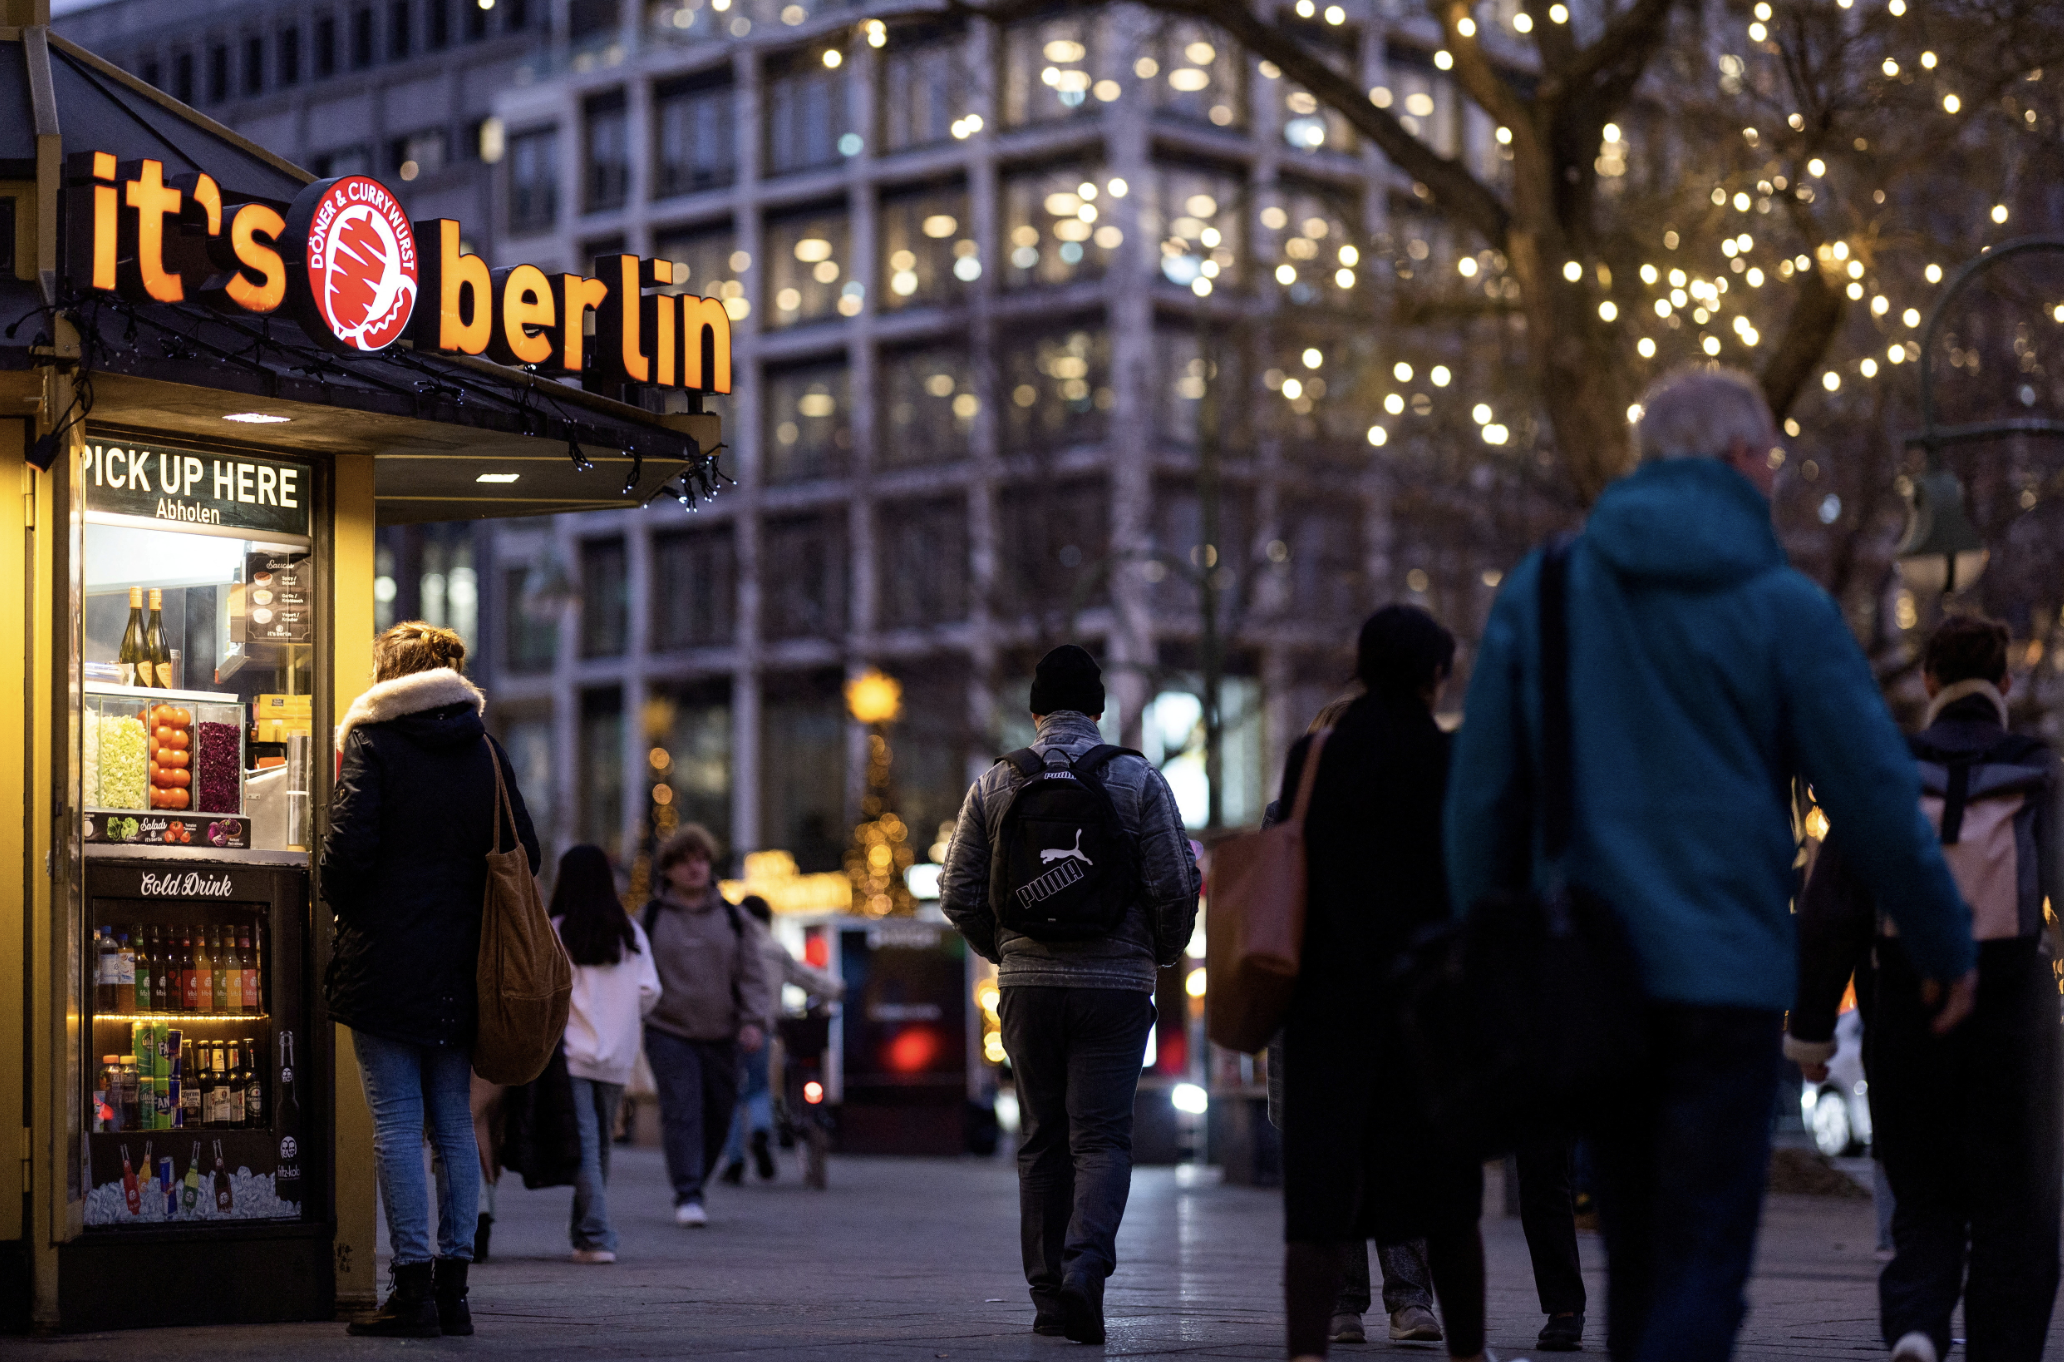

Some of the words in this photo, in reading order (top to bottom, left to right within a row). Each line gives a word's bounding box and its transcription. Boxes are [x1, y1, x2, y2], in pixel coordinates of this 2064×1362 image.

[309, 200, 337, 269] DÖNER
[335, 190, 347, 207] &
[348, 182, 415, 271] CURRYWURST
[92, 151, 287, 312] it's
[440, 219, 731, 394] berlin
[160, 453, 204, 496] UP
[213, 460, 298, 508] HERE
[156, 497, 220, 524] Abholen
[140, 817, 167, 831] Salads
[141, 872, 182, 895] Cold
[181, 872, 232, 896] Drink
[1016, 858, 1084, 909] PUMA
